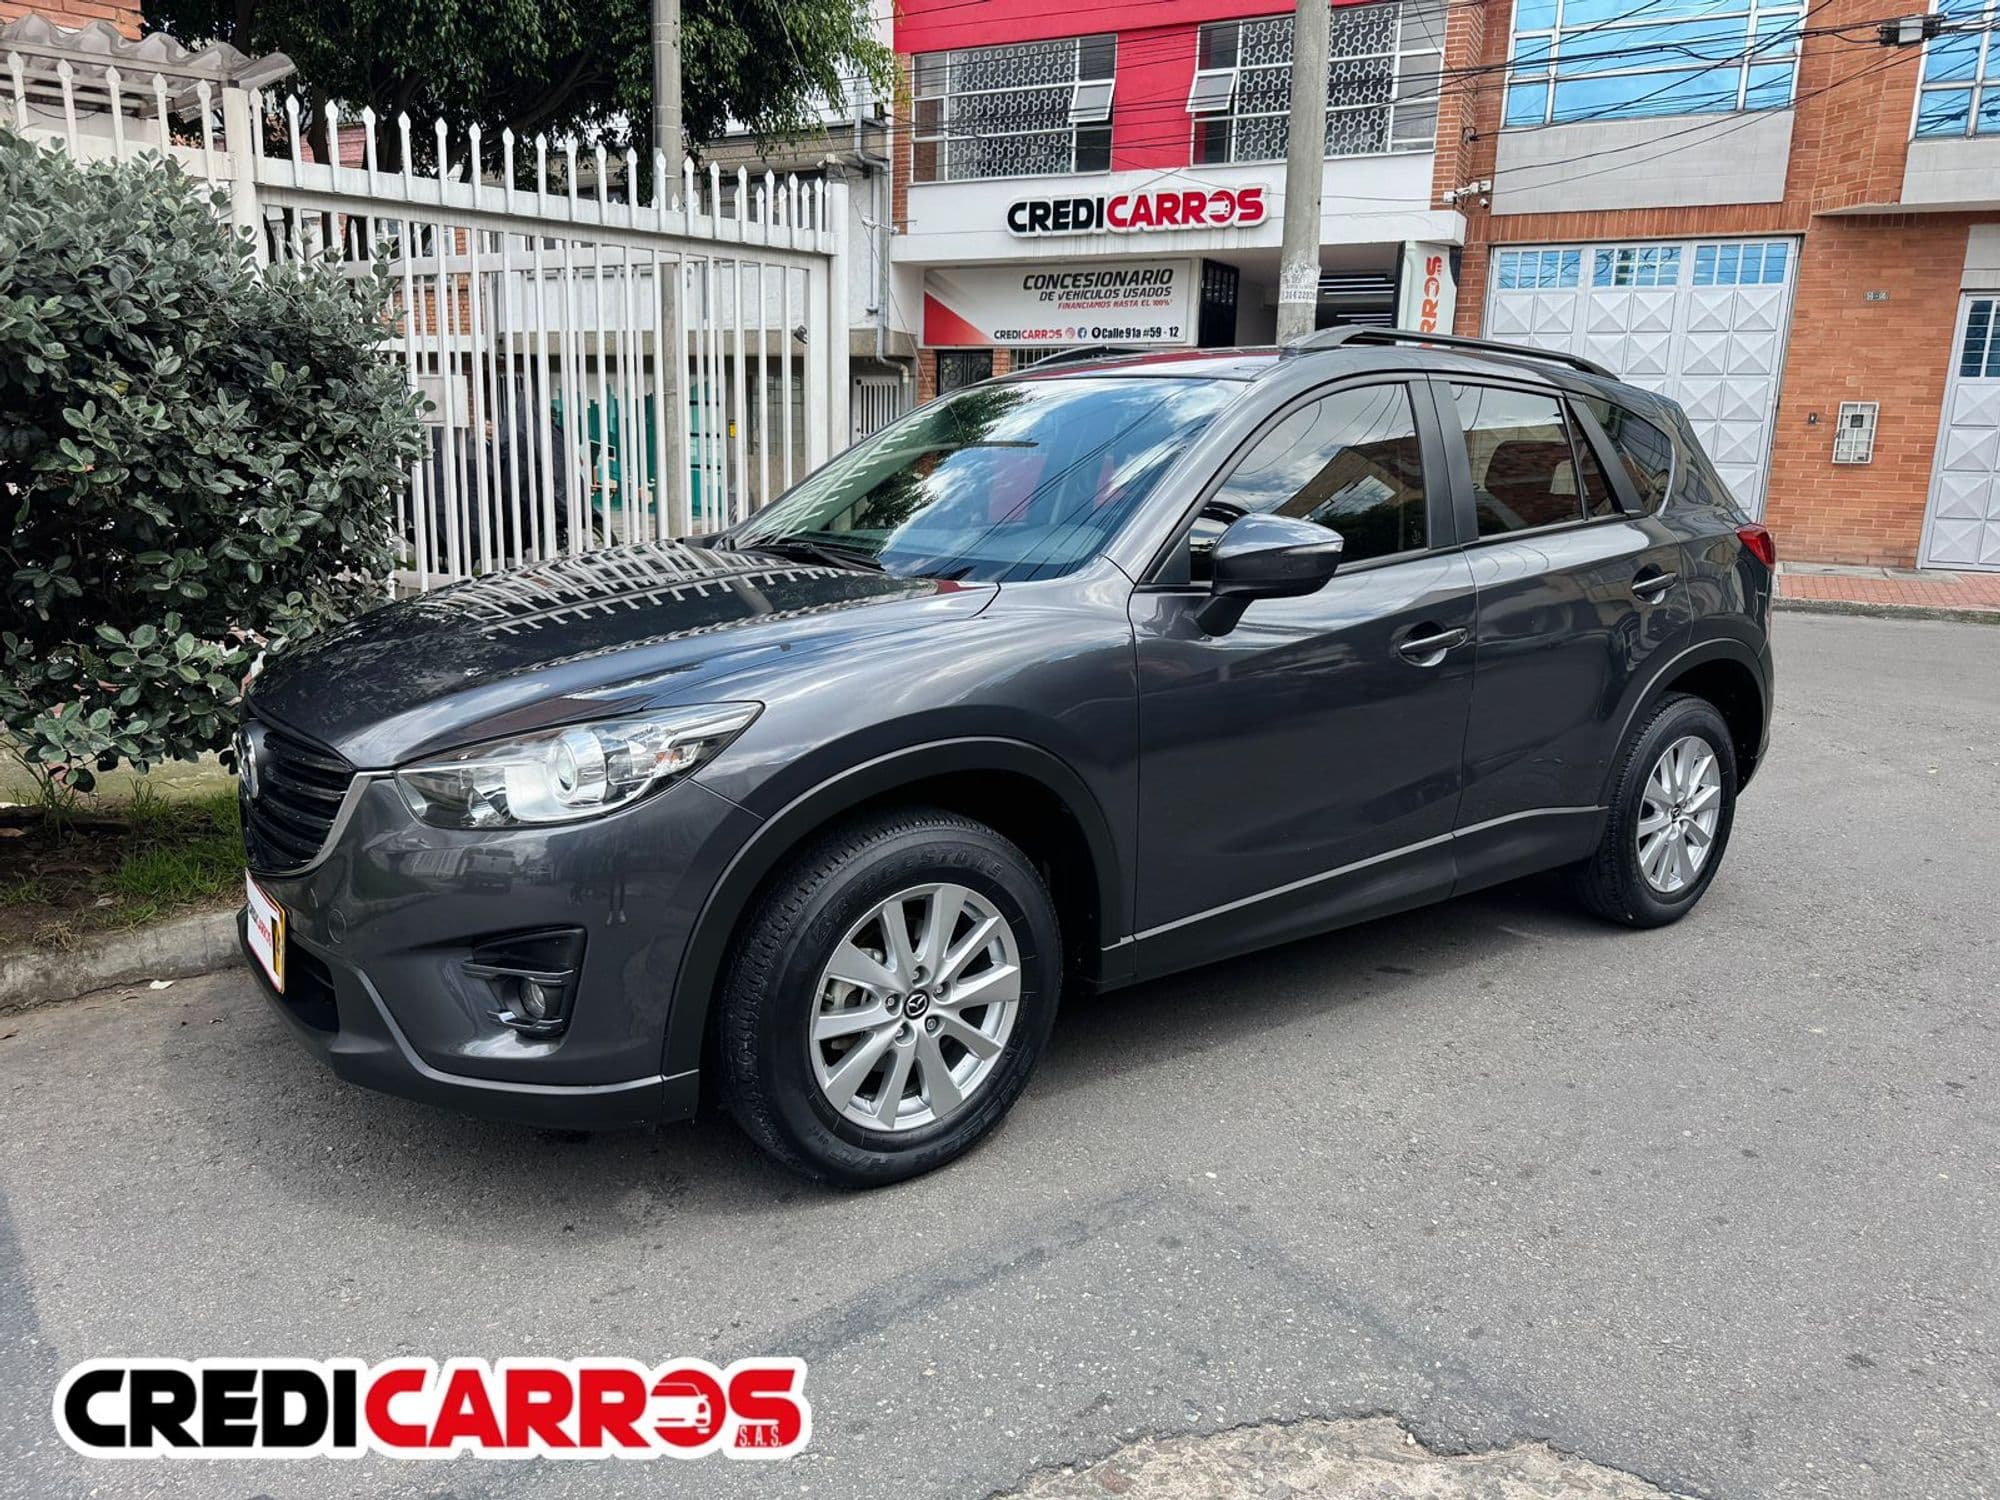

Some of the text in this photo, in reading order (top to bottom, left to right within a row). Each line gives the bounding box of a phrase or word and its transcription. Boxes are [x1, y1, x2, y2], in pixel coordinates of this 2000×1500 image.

[1007, 188, 1264, 233] CREDICARROS
[1023, 269, 1174, 291] CONCESIONARIO
[1039, 291, 1056, 301] DE
[1123, 286, 1172, 298] USADOS
[1057, 301, 1112, 310] FINANCIAMOS
[1113, 300, 1139, 308] HASTA
[994, 329, 1063, 340] CREDICARROS
[1102, 328, 1124, 338] Calle
[1125, 327, 1141, 338] 91a
[1143, 326, 1162, 338] #59
[1169, 326, 1180, 337] 12
